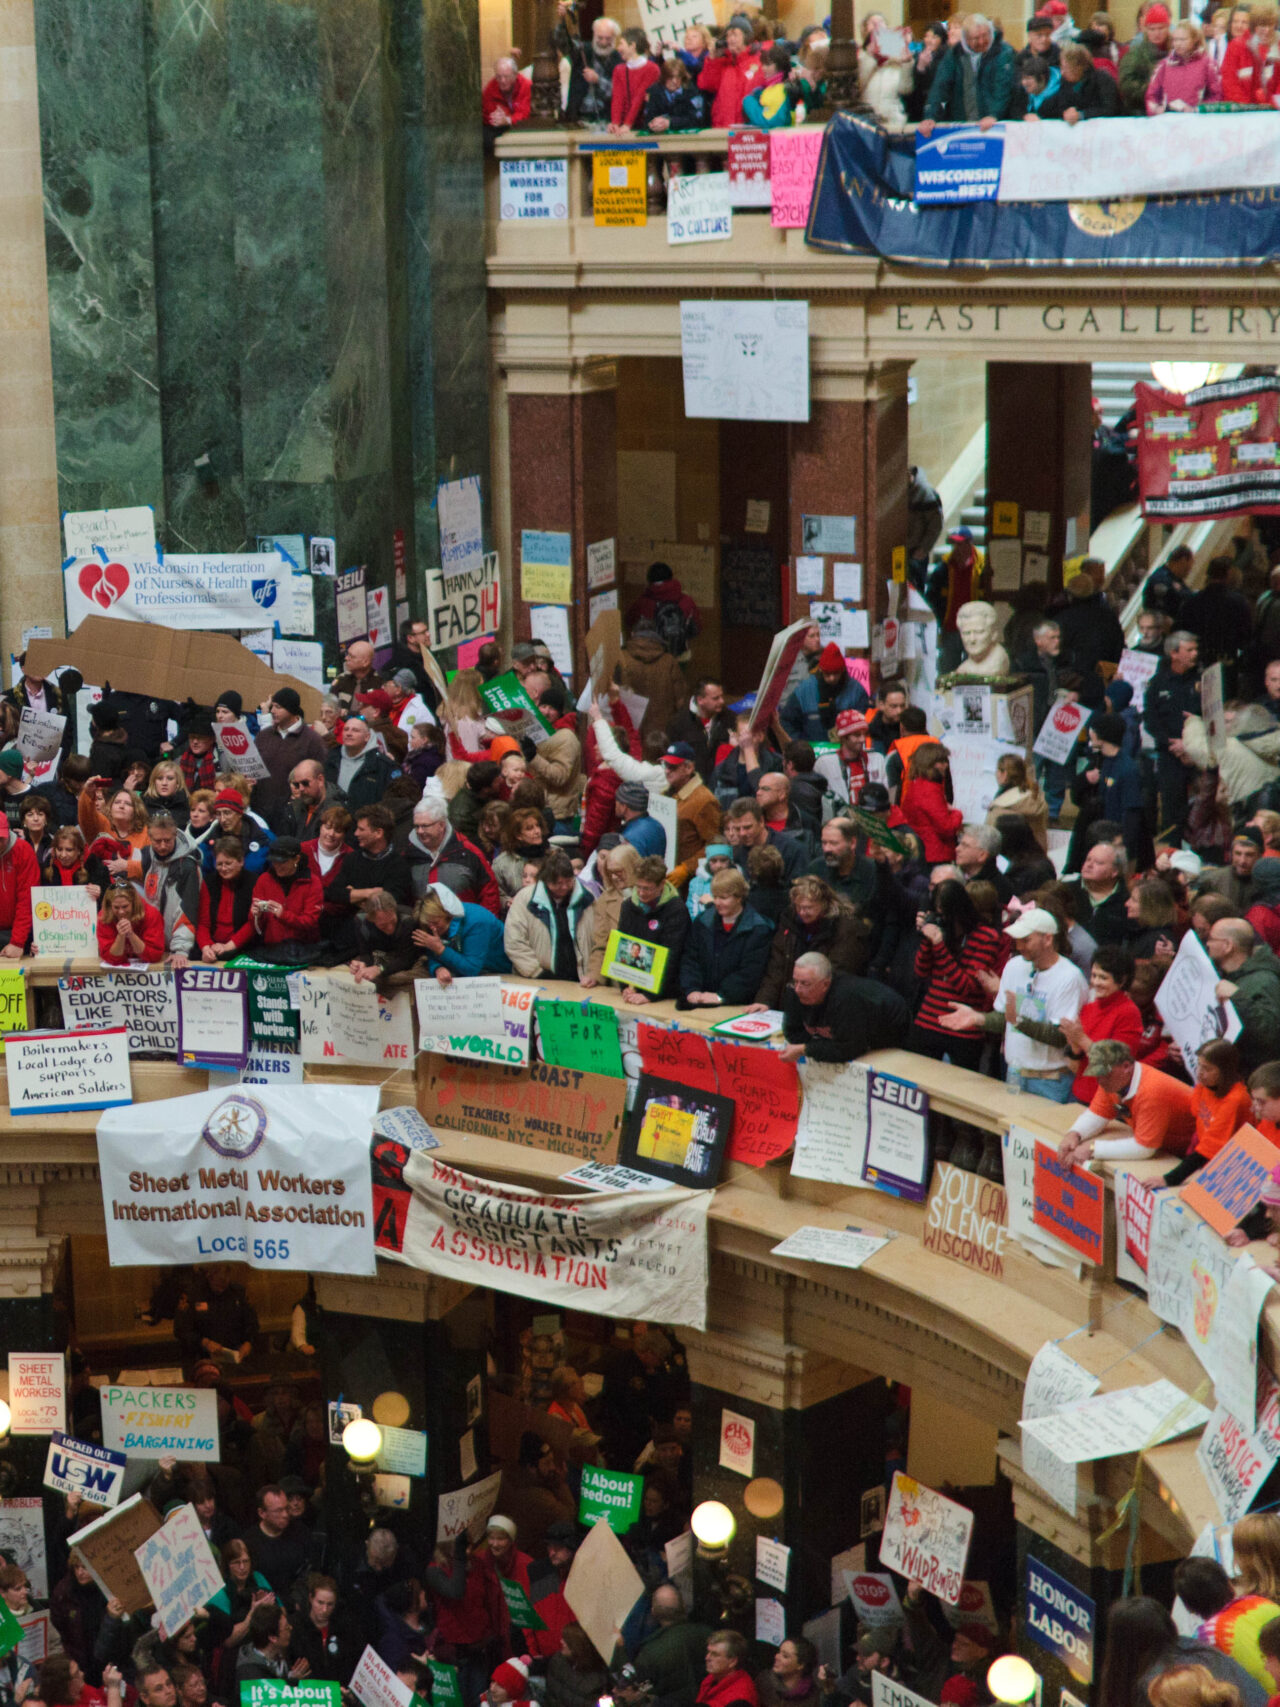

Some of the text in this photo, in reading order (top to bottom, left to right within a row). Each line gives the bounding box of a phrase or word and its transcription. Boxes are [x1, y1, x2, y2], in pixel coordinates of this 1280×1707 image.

[502, 161, 564, 174] SHEET METAL
[917, 167, 999, 184] WISCONSIN
[509, 177, 558, 188] WORKERS
[598, 187, 641, 195] SUPPORTS
[958, 183, 997, 197] BEST
[524, 192, 543, 203] FOR
[518, 207, 550, 218] LABOR
[595, 207, 645, 215] BARGAINING
[688, 217, 730, 236] CULTURE
[896, 304, 1280, 334] EAST GALLERY
[134, 560, 265, 575] Wisconsin Federation
[135, 576, 248, 589] of Nurses Health
[336, 570, 364, 591] SEIU
[135, 592, 217, 606] Professionals
[223, 735, 245, 747] STOP
[52, 904, 91, 927] busting
[114, 973, 171, 986] ABOUT
[182, 971, 241, 990] SEIU
[69, 988, 172, 1006] EDUCATORS,
[256, 995, 289, 1011] Stands
[76, 1003, 164, 1020] LIKE THEY
[262, 1009, 284, 1024] with
[123, 1020, 176, 1033] ABOUT
[253, 1022, 295, 1038] Workers
[570, 1024, 603, 1040] FOR
[22, 1039, 109, 1057] Boilermakers
[449, 1034, 526, 1065] WORLD.
[648, 1032, 685, 1051] SAY
[18, 1052, 113, 1071] Local Lodge 60
[39, 1068, 95, 1083] supports
[530, 1068, 583, 1089] COAST
[22, 1081, 126, 1100] American Soldiers
[871, 1077, 925, 1111] SEIU
[462, 1105, 510, 1125] TEACHERS
[739, 1117, 769, 1134] YOU
[128, 1167, 346, 1196] Sheet Metal Workers
[936, 1164, 1007, 1222] YOU CAN
[112, 1196, 365, 1228] International Association
[443, 1187, 590, 1238] GRADUATE
[928, 1199, 1009, 1257] SILENCE
[1035, 1196, 1101, 1250] SOLIDARITY
[253, 1239, 290, 1260] 565
[431, 1225, 608, 1290] ASSOCIATION
[922, 1221, 1004, 1277] WISCONSIN
[19, 1363, 54, 1374] SHEET
[19, 1376, 53, 1386] METAL
[14, 1387, 61, 1398] WORKERS
[109, 1389, 196, 1409] PACKERS
[62, 1437, 93, 1455] LOCKED
[124, 1433, 214, 1450] BARGAINING
[1220, 1414, 1262, 1486] JUSTICE
[51, 1452, 116, 1493] USW
[589, 1475, 635, 1495] About
[854, 1583, 887, 1597] STOP
[1028, 1570, 1092, 1633] HONOR
[1028, 1603, 1090, 1666] LABOR
[251, 1684, 333, 1701] It's About
